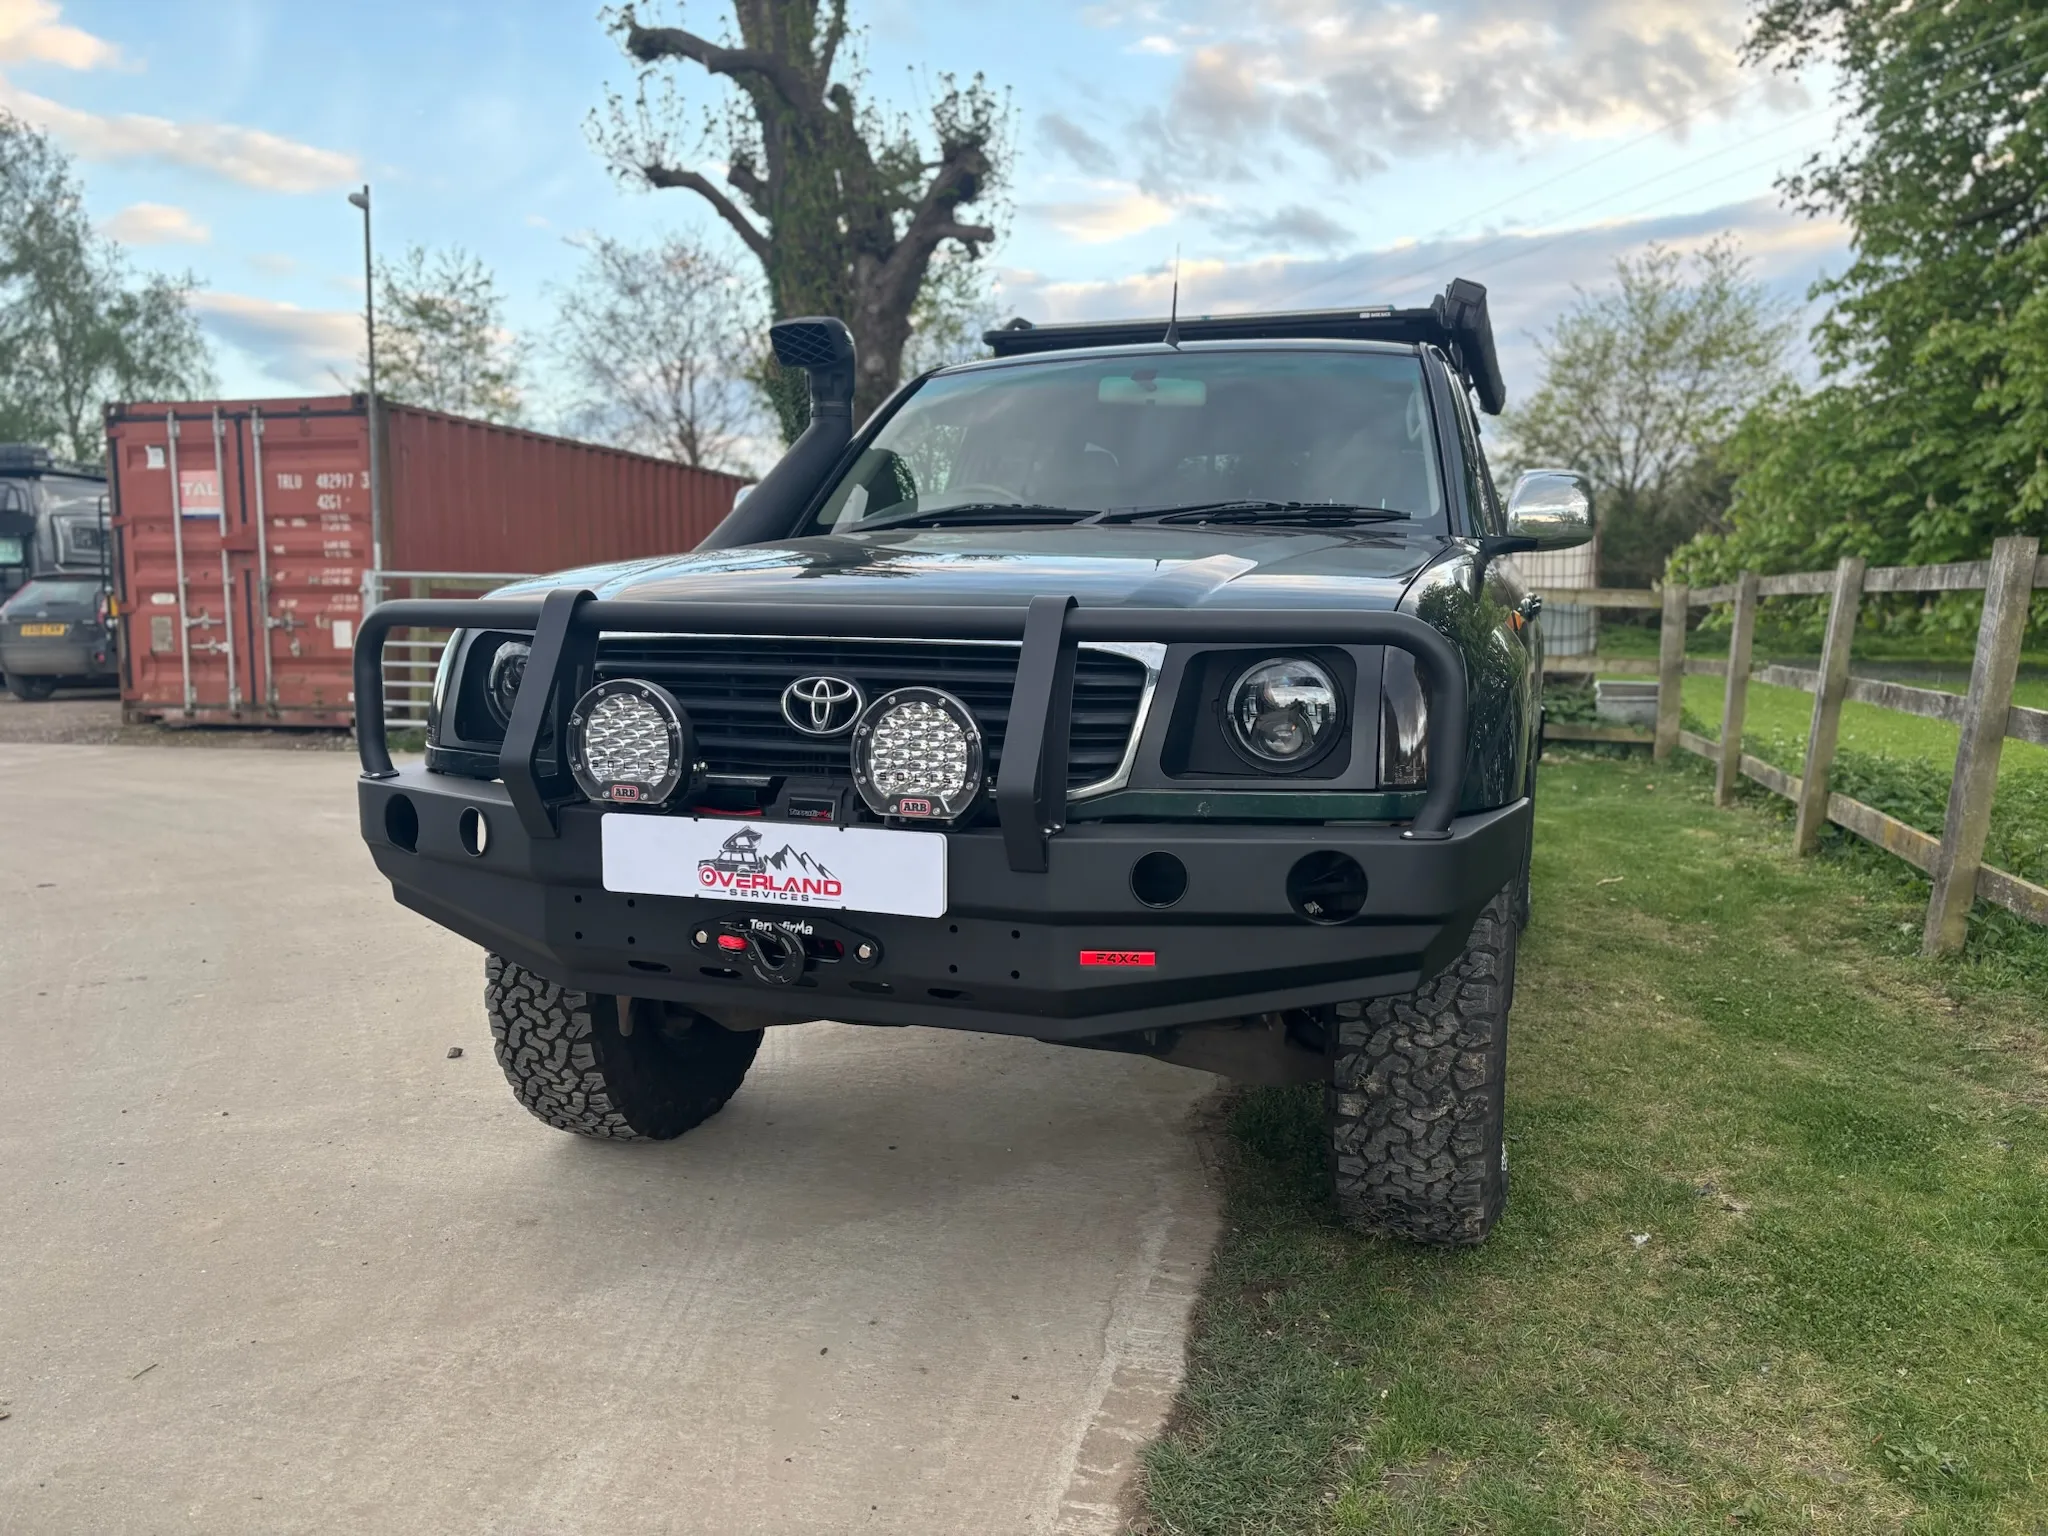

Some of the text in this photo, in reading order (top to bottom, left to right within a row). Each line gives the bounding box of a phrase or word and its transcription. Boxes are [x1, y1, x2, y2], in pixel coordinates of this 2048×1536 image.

[315, 472, 354, 490] 482917
[180, 482, 218, 496] TAL
[592, 760, 657, 771] SOLIS
[879, 772, 951, 784] SOLIS
[614, 788, 636, 797] ARB
[903, 802, 927, 812] ARB
[699, 866, 842, 897] OVERLAND
[729, 888, 809, 902] SERVICES
[1096, 953, 1140, 964] F4X4
